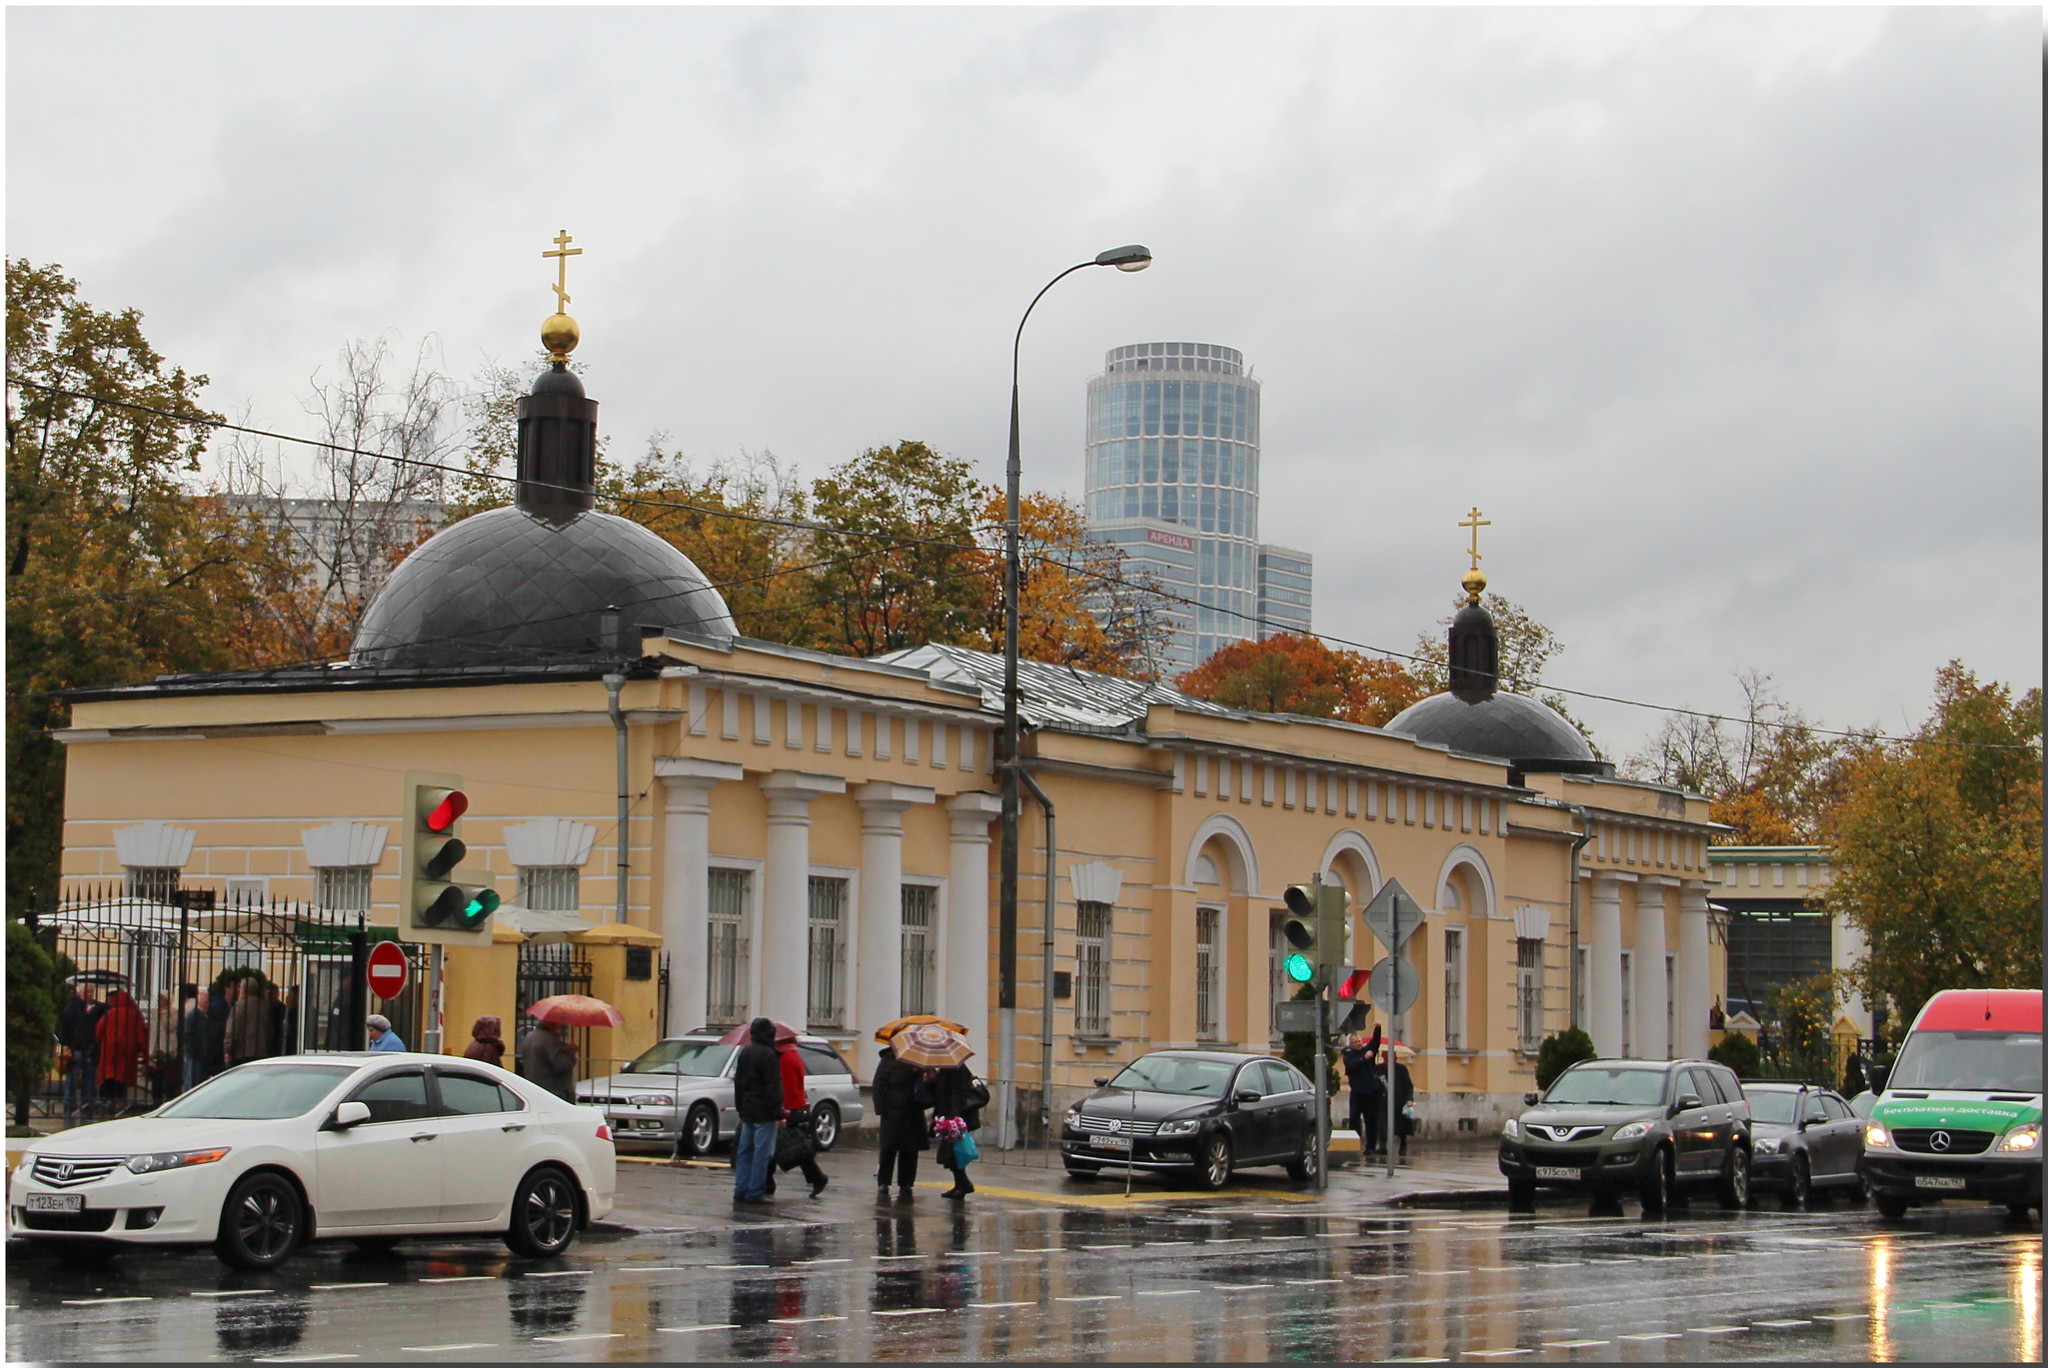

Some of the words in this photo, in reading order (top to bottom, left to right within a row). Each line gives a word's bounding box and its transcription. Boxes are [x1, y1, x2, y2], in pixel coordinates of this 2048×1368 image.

[1150, 531, 1190, 549] АРЕНДА
[30, 1196, 64, 1210] Т123ЕН
[65, 1196, 80, 1209] 197
